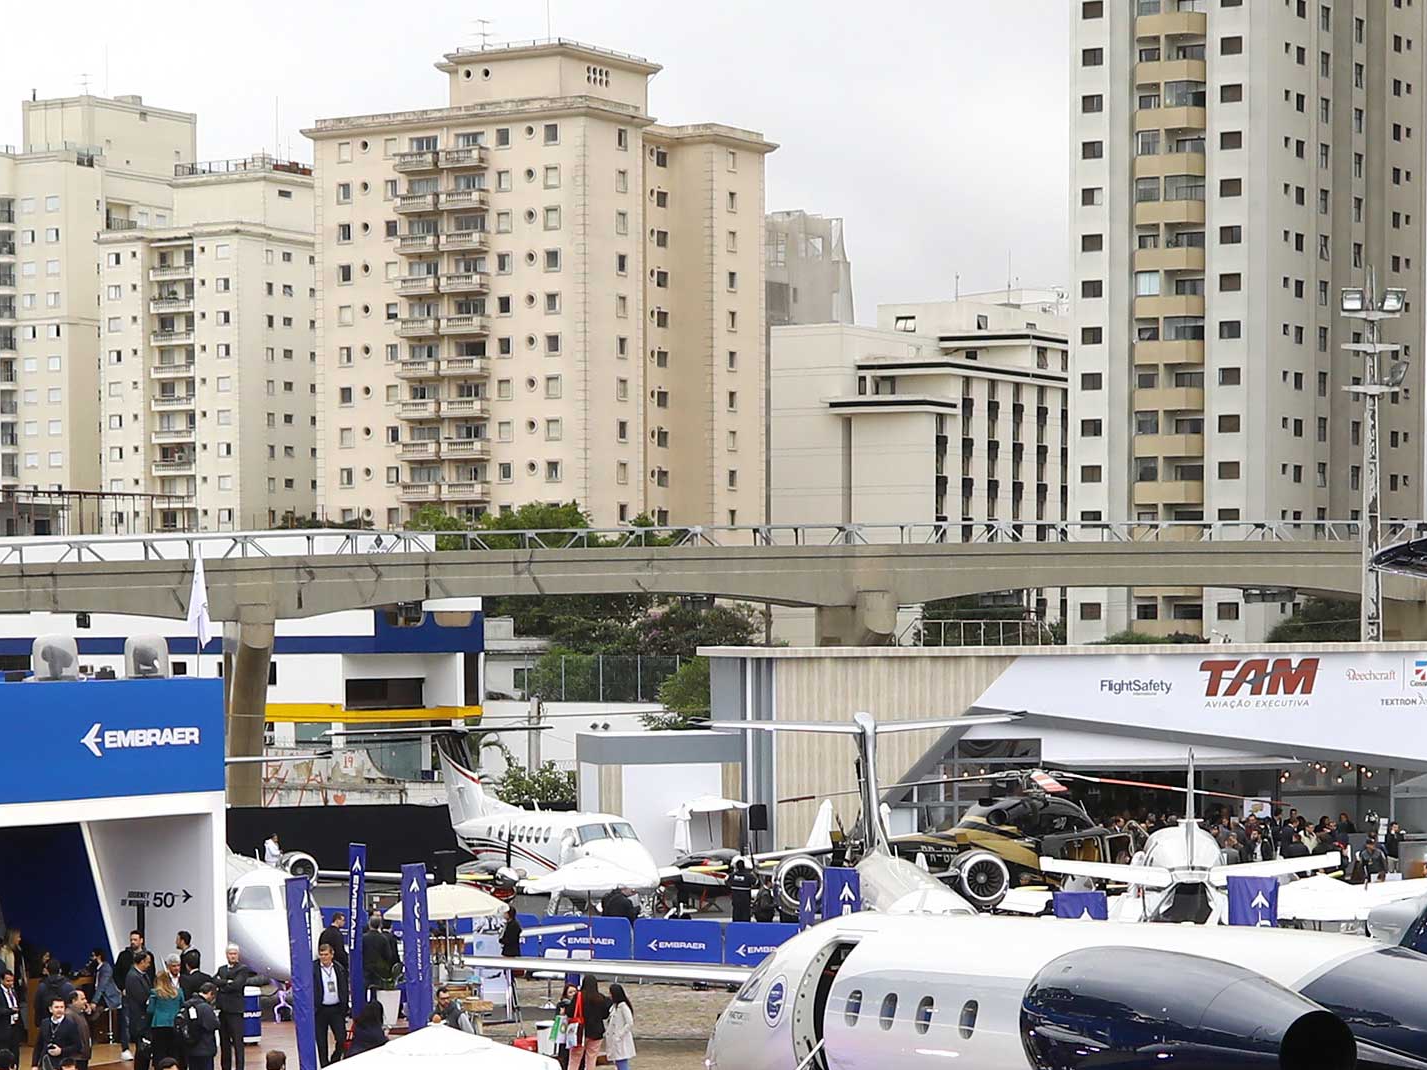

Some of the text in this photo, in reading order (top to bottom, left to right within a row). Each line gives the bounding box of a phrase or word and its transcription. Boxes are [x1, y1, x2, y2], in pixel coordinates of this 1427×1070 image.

[1199, 658, 1320, 697] TAM
[1345, 667, 1396, 681] Beechcraft
[1100, 679, 1172, 695] FlightSafety
[1204, 699, 1310, 710] AVIAÇÃO EXECUTIVA
[1381, 698, 1417, 706] TEXTRON
[104, 727, 200, 748] EMBRAER
[153, 892, 175, 908] 50
[349, 874, 360, 950] EMBRAER
[567, 937, 615, 946] EMBRAER
[659, 941, 706, 951] EMBRAER
[748, 945, 777, 955] EMBR
